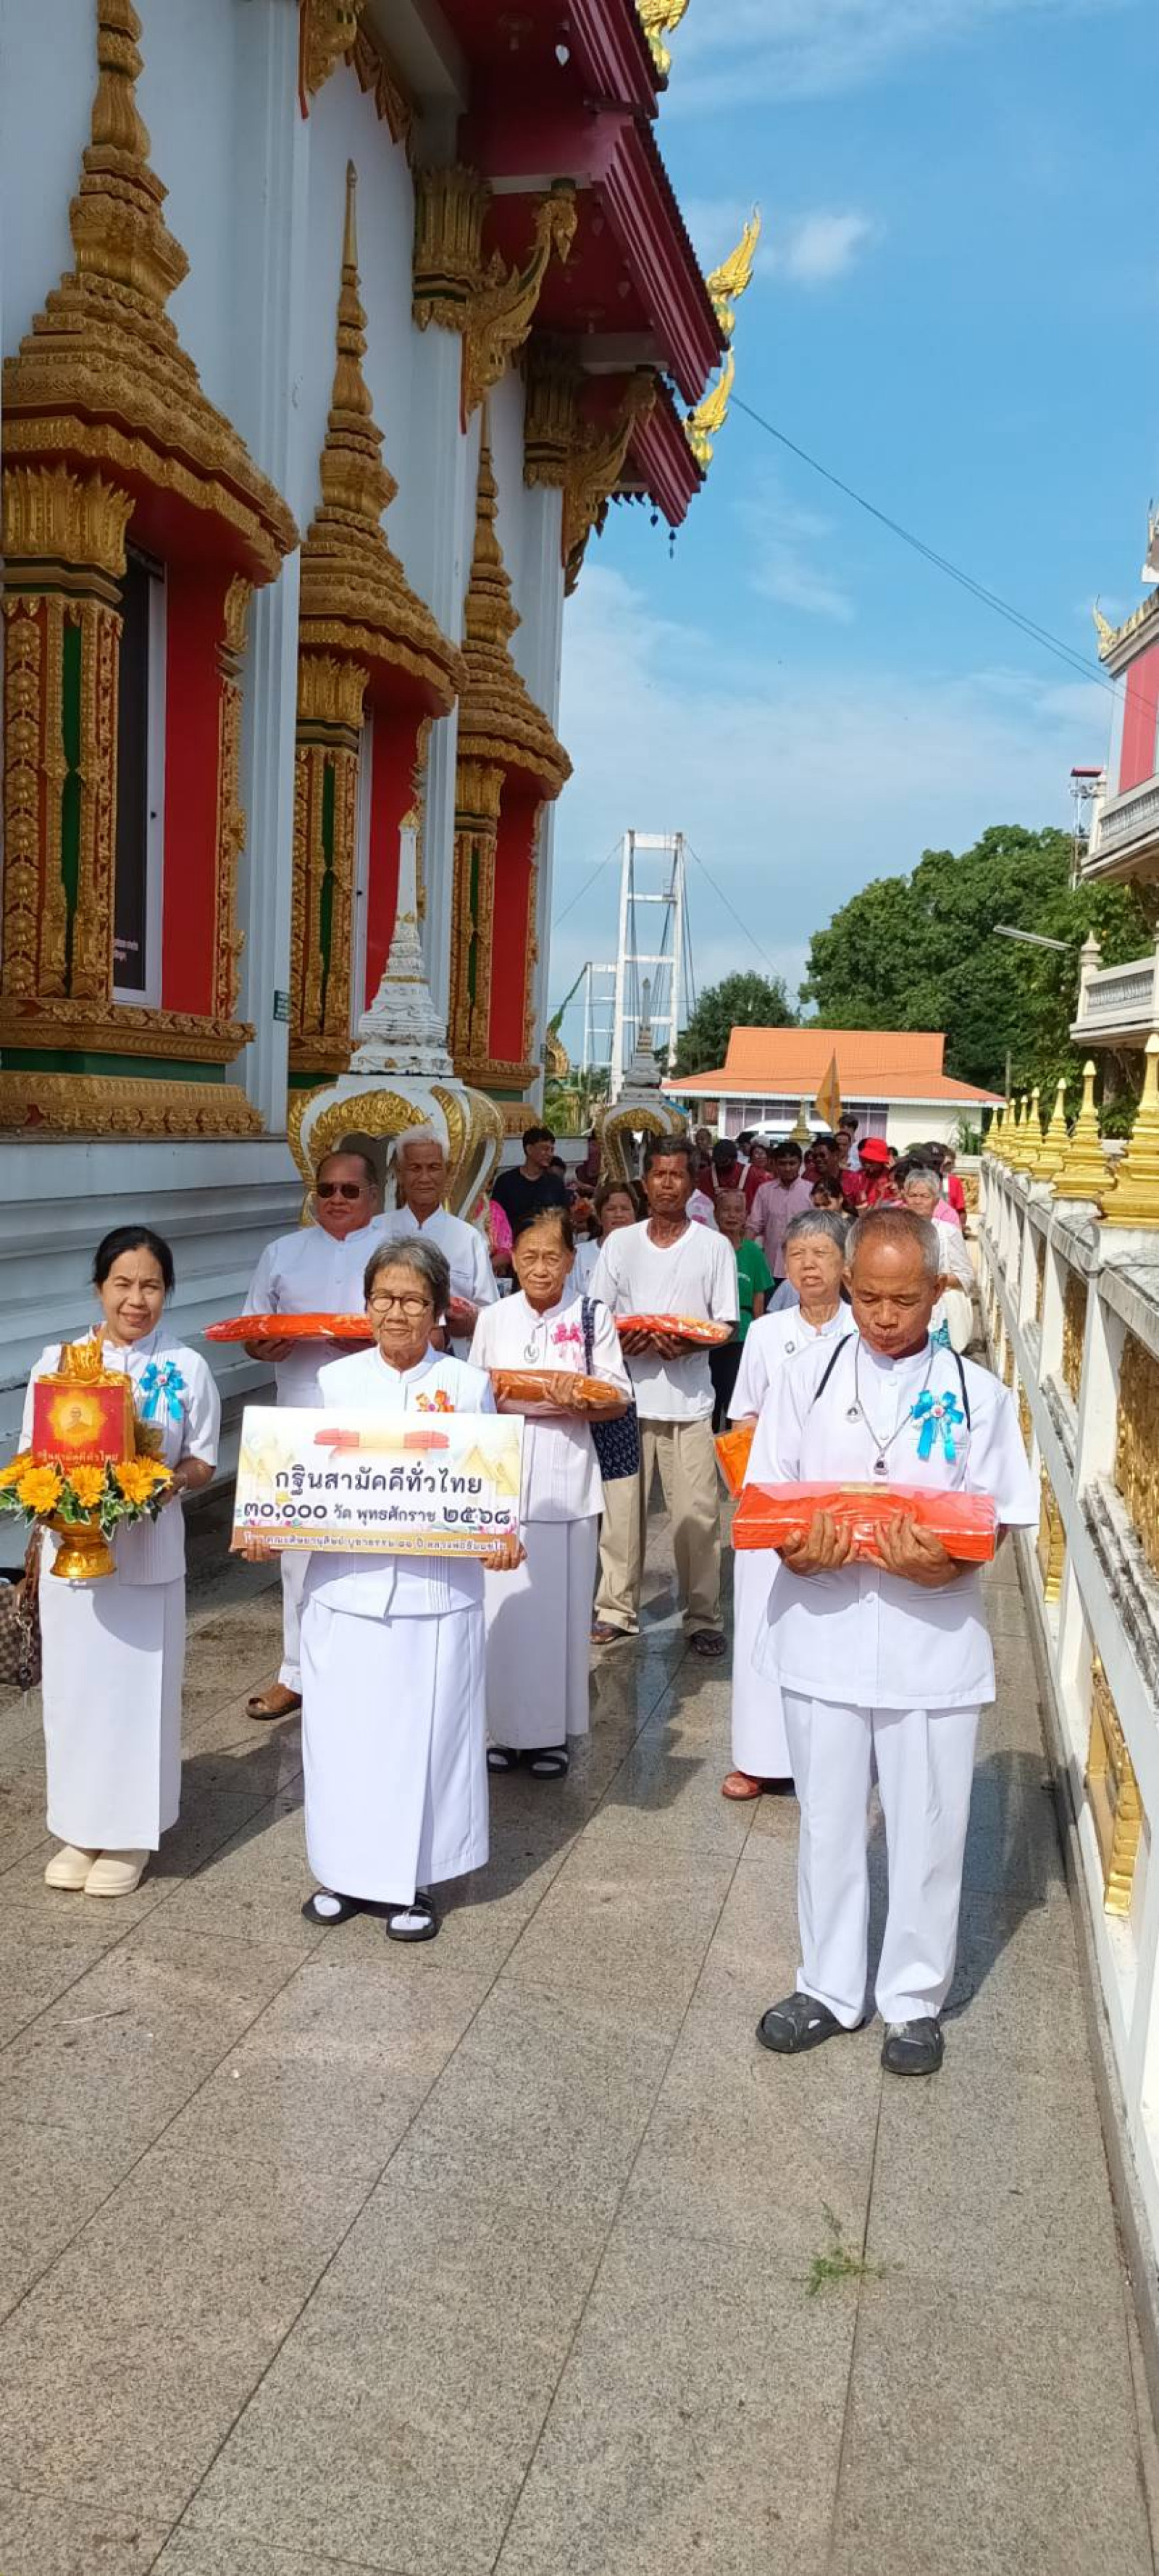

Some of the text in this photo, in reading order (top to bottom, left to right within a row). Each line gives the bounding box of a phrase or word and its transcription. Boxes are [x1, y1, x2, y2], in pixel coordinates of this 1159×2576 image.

[275, 1462, 482, 1496] กฐินสามัคคีทั่วไทย
[244, 1502, 511, 1526] ๓๐,๐๐๐ วัด พุทธศักราช ๒๕๖๘
